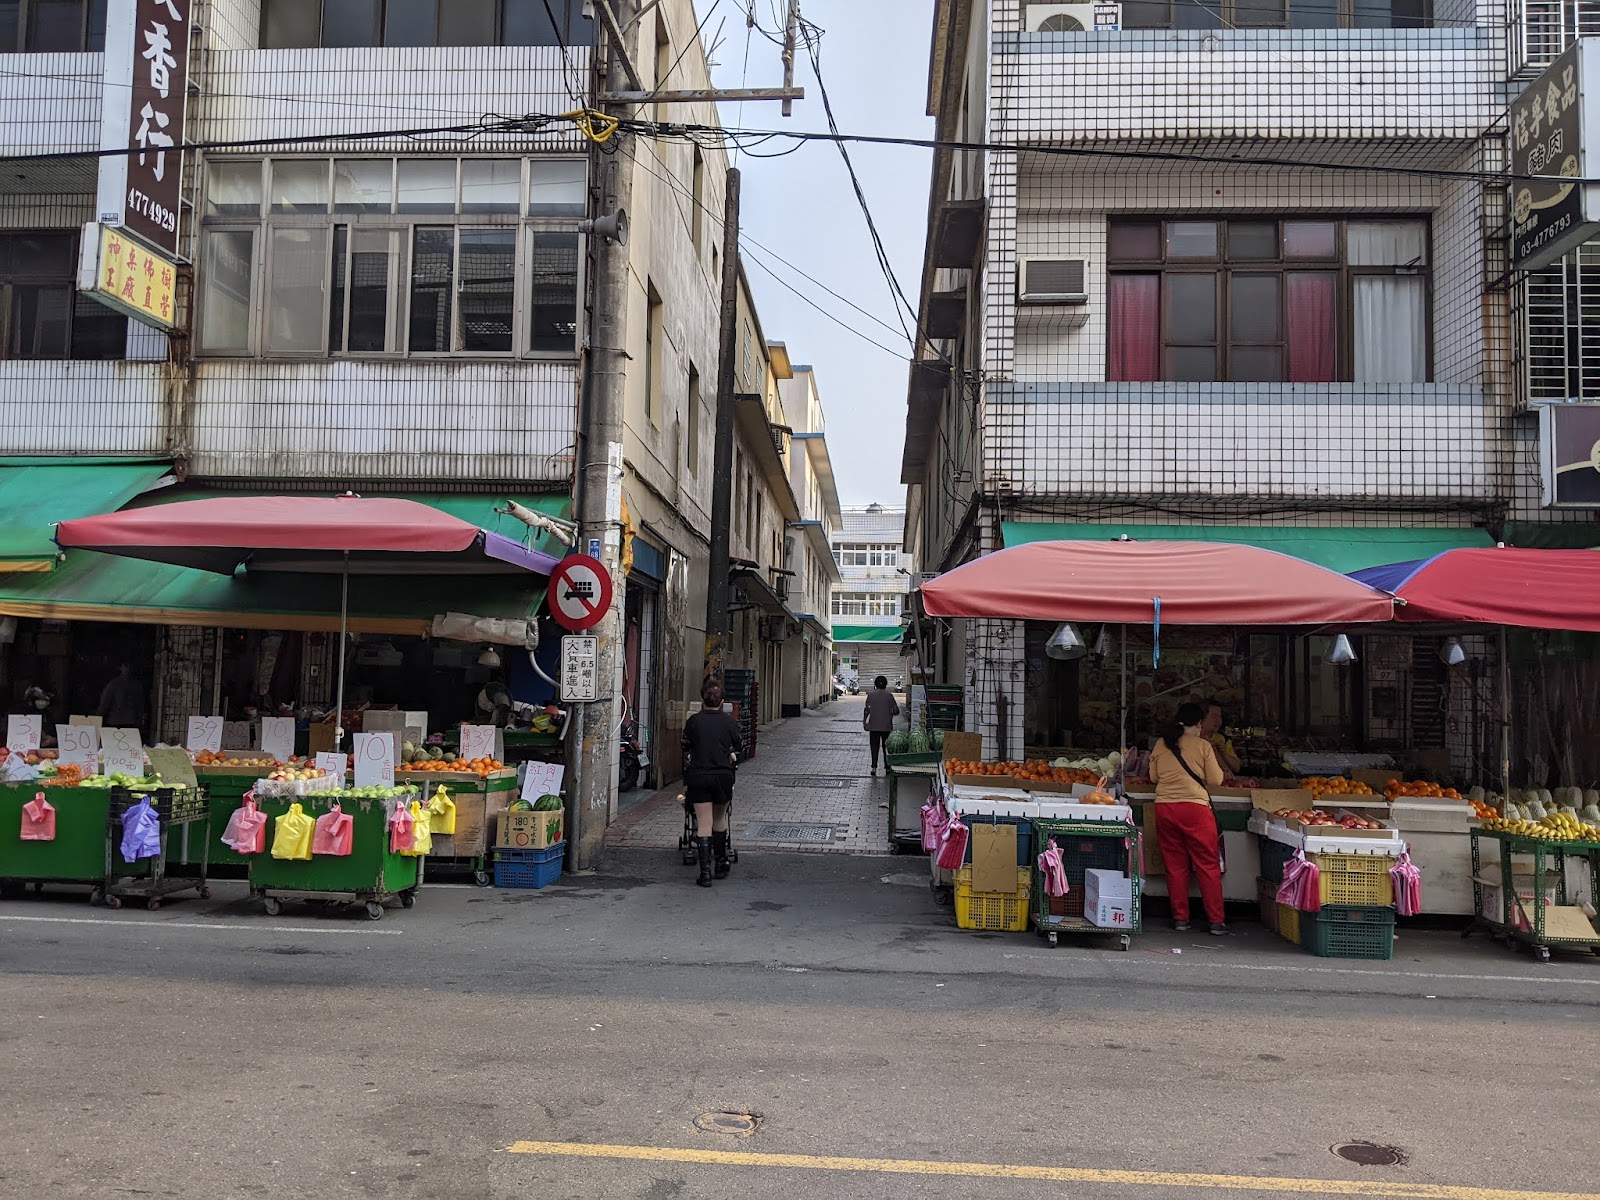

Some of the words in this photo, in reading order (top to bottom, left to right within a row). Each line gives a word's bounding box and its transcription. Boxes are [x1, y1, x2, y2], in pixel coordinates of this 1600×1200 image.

[1094, 6, 1118, 14] SAMPO
[135, 0, 182, 182] 香行
[1514, 64, 1577, 151] 信孚食品
[1527, 128, 1563, 175] 豬肉
[128, 187, 175, 233] 4774929
[1520, 212, 1571, 258] 03-4776793
[566, 639, 579, 698] 大貨車進入
[1380, 671, 1391, 680] 97
[63, 728, 91, 752] 50
[193, 720, 217, 746] 39
[226, 723, 244, 739] 80
[265, 720, 287, 741] 10
[472, 728, 494, 755] 39
[358, 736, 386, 763] 10
[325, 754, 338, 772] 5
[528, 776, 554, 794] 15
[514, 816, 529, 826] 180
